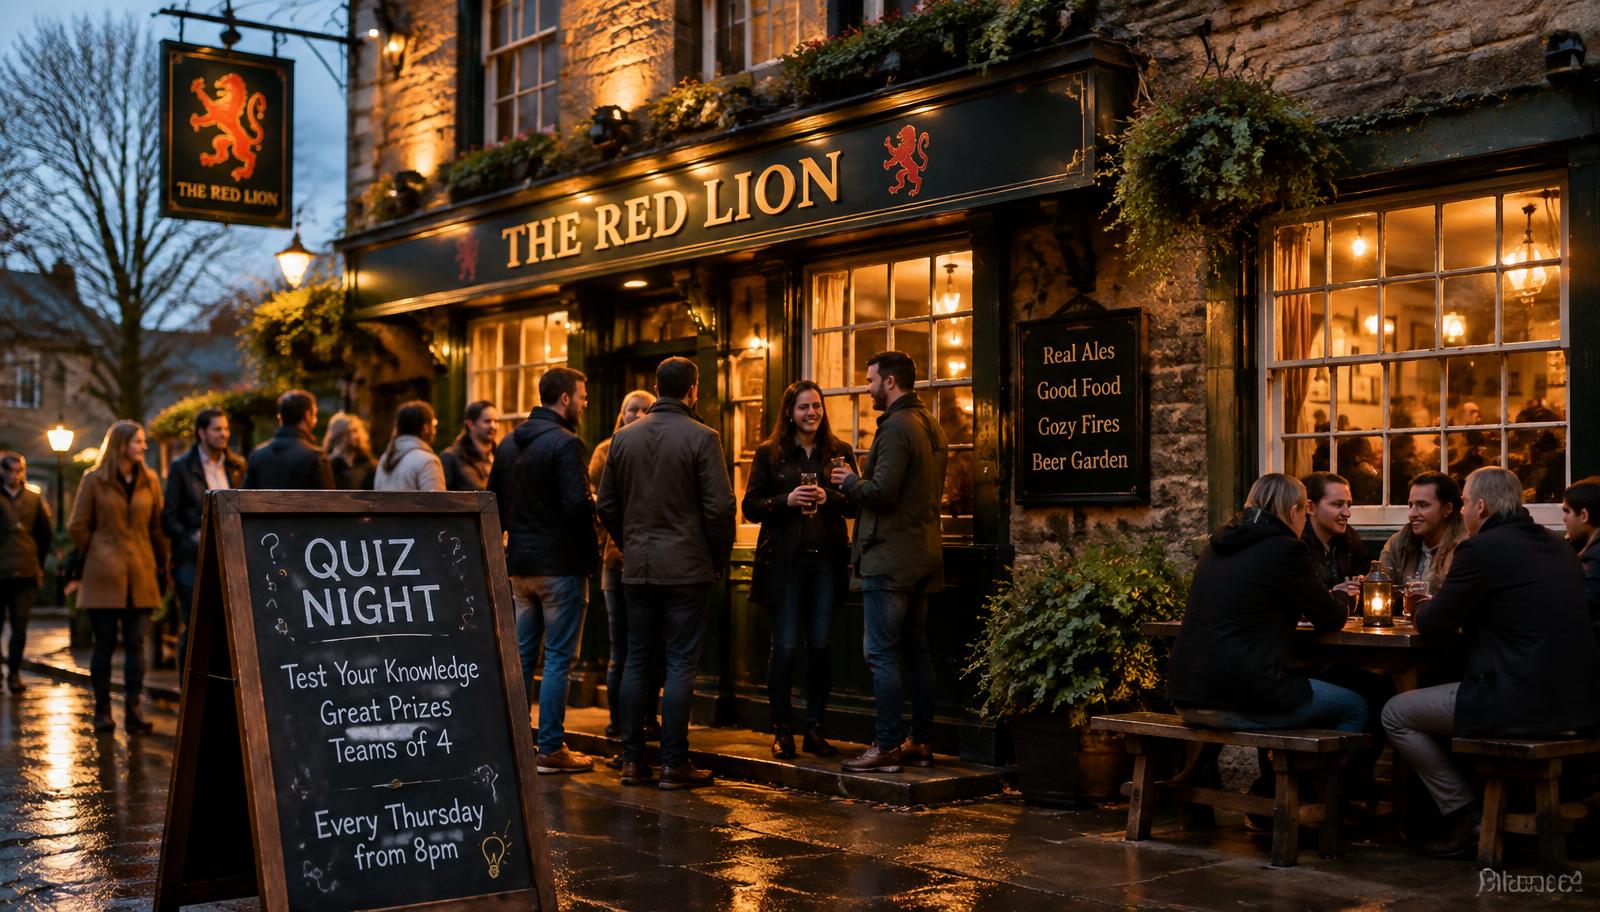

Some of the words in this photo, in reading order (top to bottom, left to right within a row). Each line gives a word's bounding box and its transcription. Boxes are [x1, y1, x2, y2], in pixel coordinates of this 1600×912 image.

[177, 181, 207, 198] THE
[210, 184, 241, 201] RED
[244, 189, 278, 206] LION
[502, 212, 582, 268] THE
[594, 189, 688, 251] RED
[703, 150, 842, 228] LION
[1043, 344, 1077, 365] Real
[1081, 341, 1115, 361] Ales
[1037, 379, 1077, 400] Good
[1081, 375, 1121, 397] Food
[1081, 414, 1120, 434] Fires
[1032, 452, 1067, 471] Beer
[1071, 449, 1128, 469] Garden
[304, 537, 421, 582] QUIZ
[302, 584, 440, 629] NIGHT
[280, 663, 328, 690] Test
[334, 660, 378, 686] Your
[384, 655, 480, 688] Knowledge
[320, 698, 381, 726] Great
[390, 696, 453, 720] Prizes
[329, 738, 398, 763] Teams
[406, 730, 427, 757] of
[436, 728, 453, 754] 4
[315, 809, 378, 841] Every
[384, 797, 484, 831] Thursday
[354, 843, 407, 870] from
[414, 837, 459, 870] 8pm
